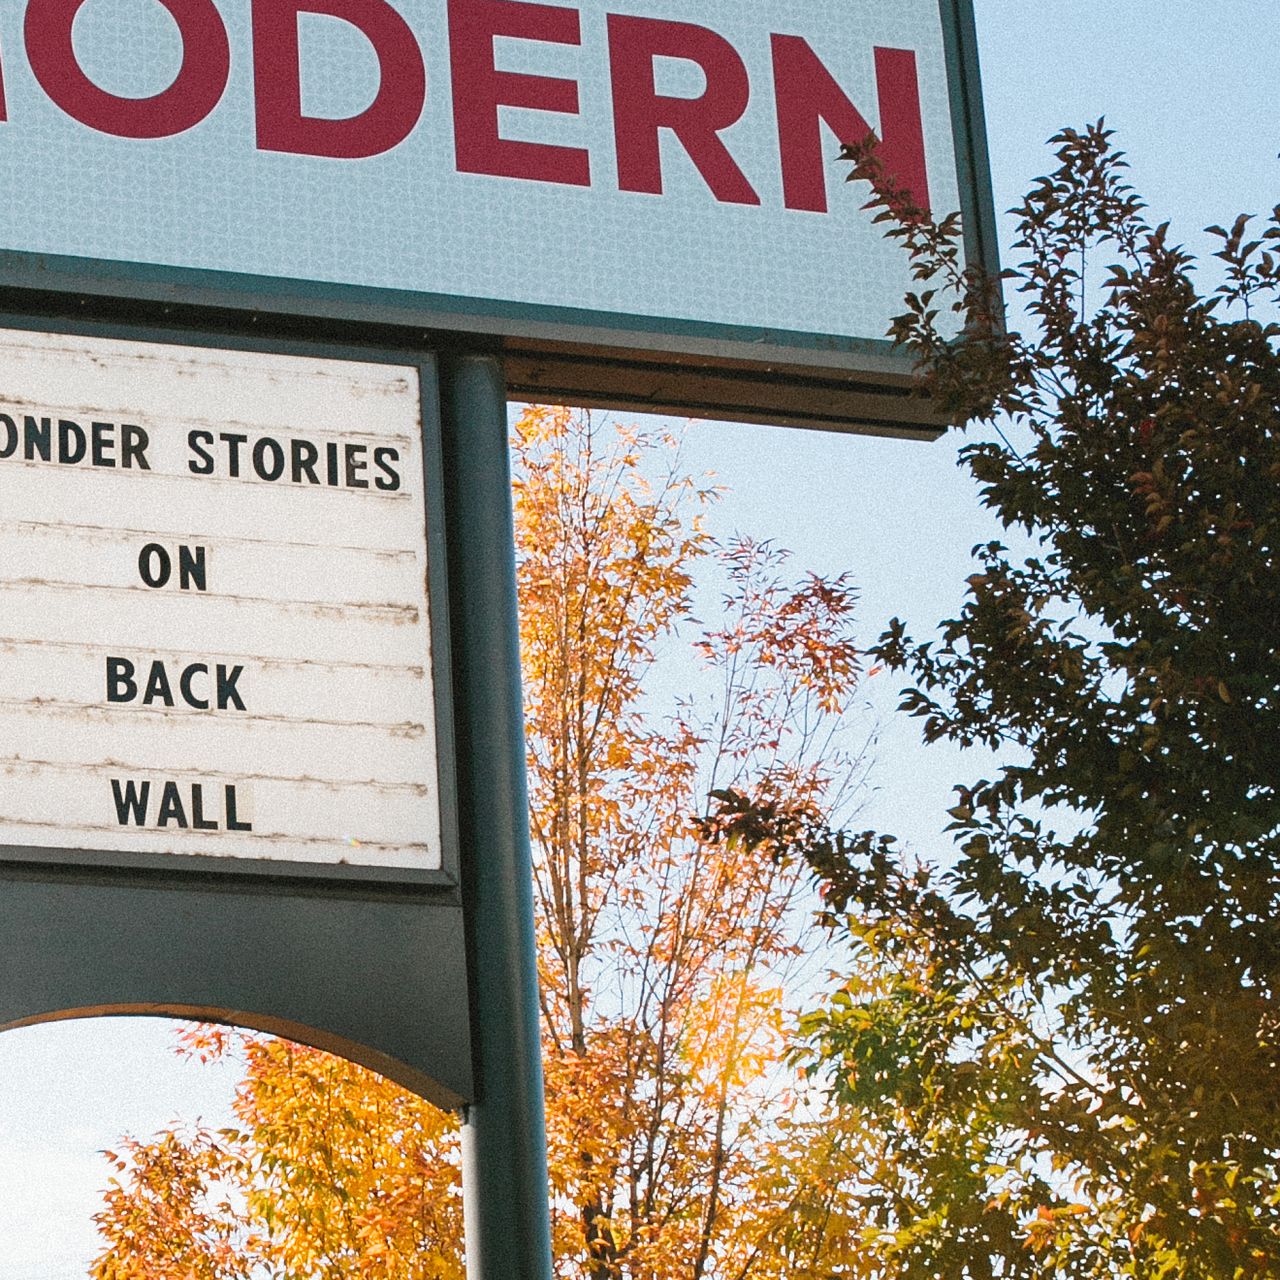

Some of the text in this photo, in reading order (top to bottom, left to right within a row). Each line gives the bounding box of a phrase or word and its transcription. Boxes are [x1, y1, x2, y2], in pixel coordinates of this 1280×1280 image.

[187, 430, 401, 491] STORIES
[138, 543, 207, 591] ON
[106, 656, 247, 711] BACK
[110, 779, 252, 831] WALL
